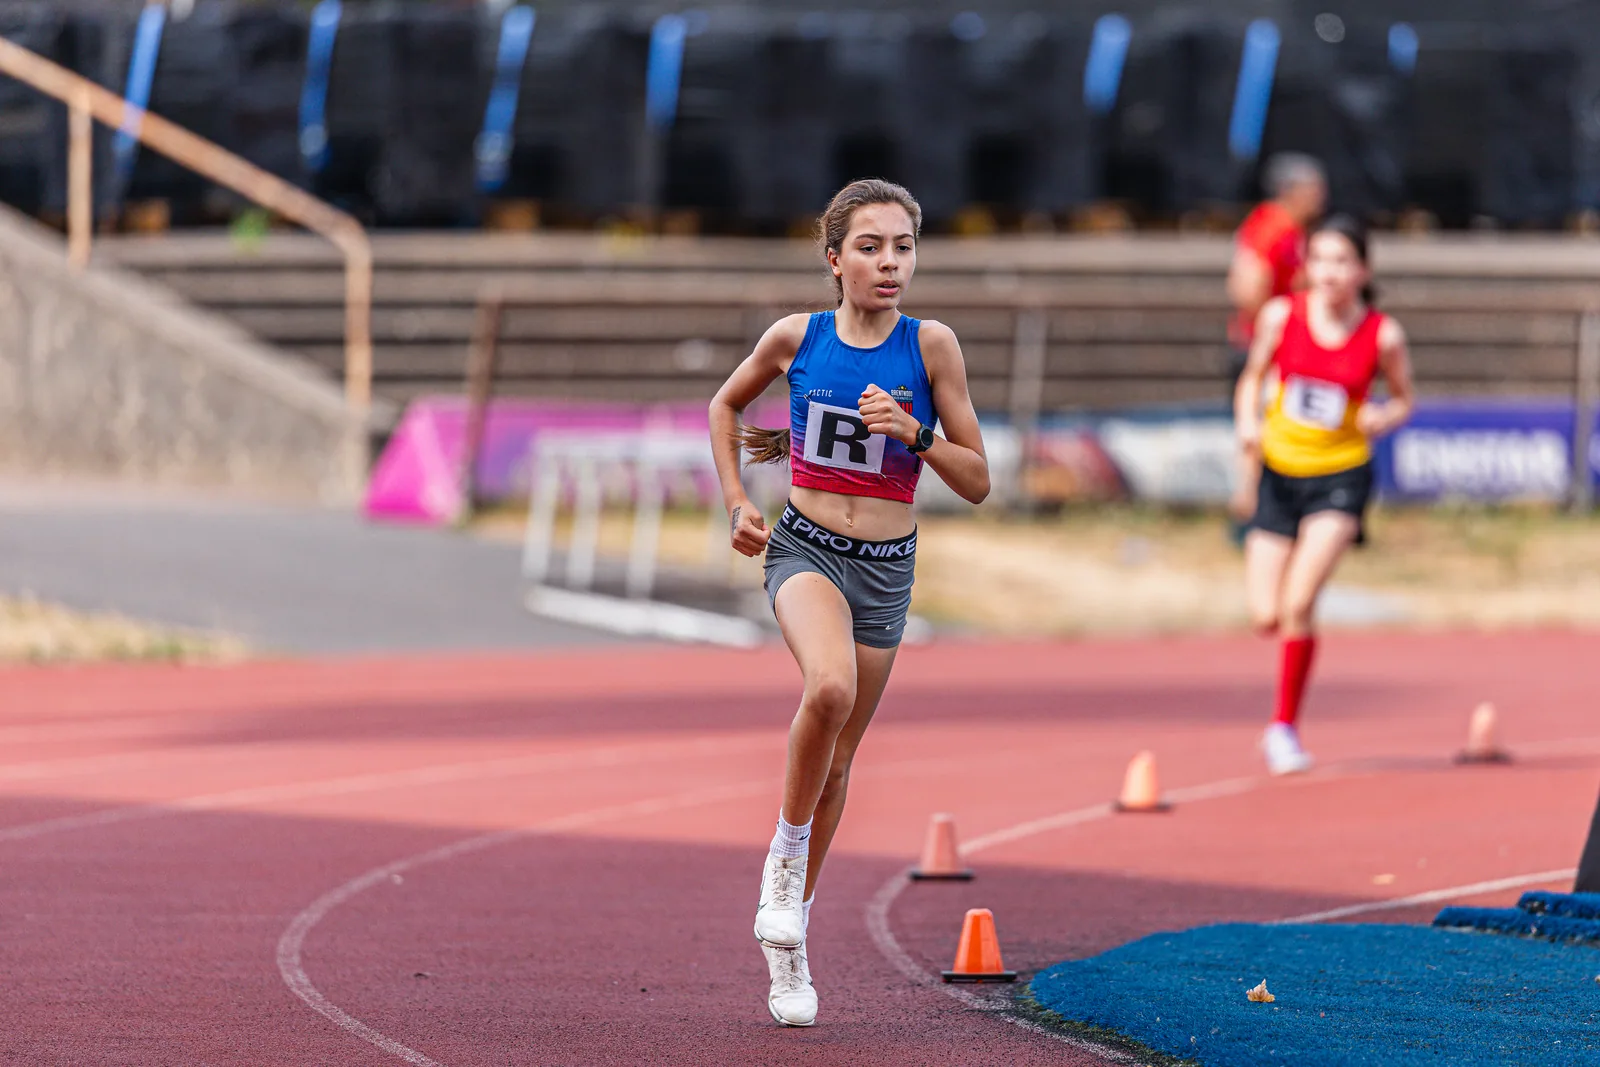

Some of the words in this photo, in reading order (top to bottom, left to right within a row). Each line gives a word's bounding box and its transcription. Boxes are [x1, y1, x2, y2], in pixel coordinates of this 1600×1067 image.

[816, 410, 872, 464] R
[791, 517, 853, 551] PRO
[858, 535, 917, 558] NIKE
